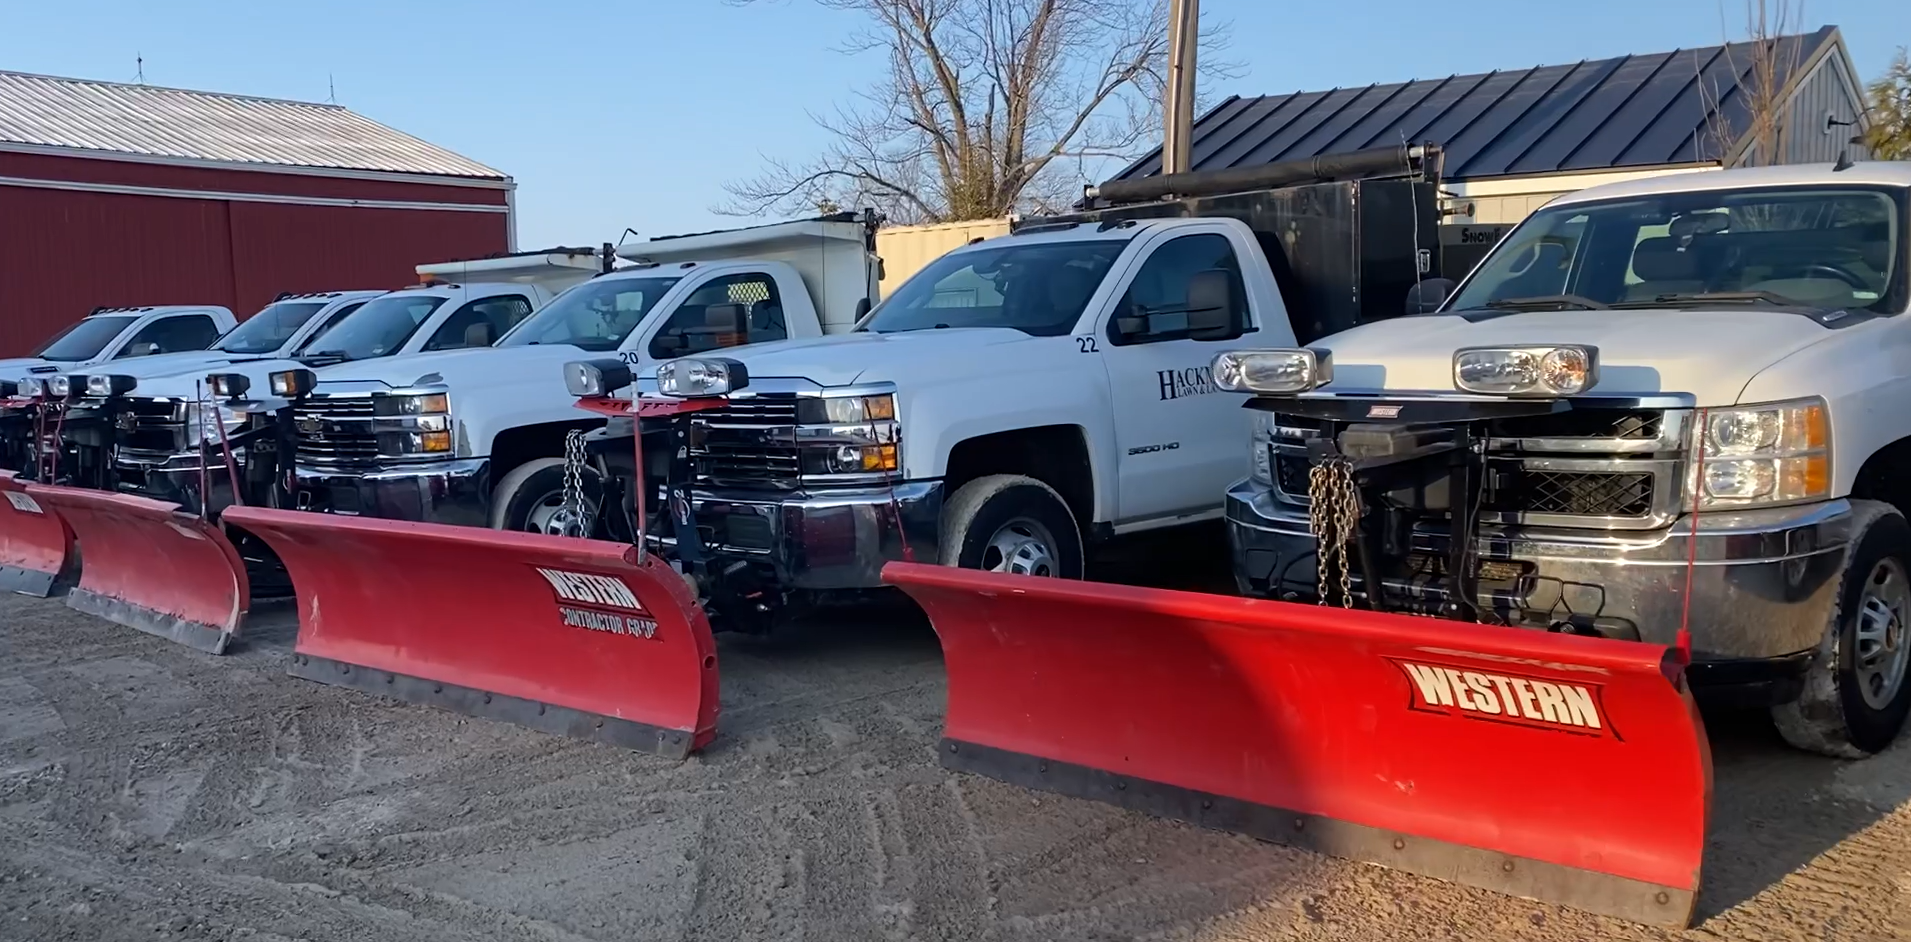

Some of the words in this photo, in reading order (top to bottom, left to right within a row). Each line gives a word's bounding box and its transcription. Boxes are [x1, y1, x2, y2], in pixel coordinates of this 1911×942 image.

[1076, 336, 1099, 353] 22
[619, 352, 639, 365] 20
[1162, 441, 1180, 451] HD
[535, 567, 642, 611] WESTERN
[1403, 663, 1602, 729] WESTERN
